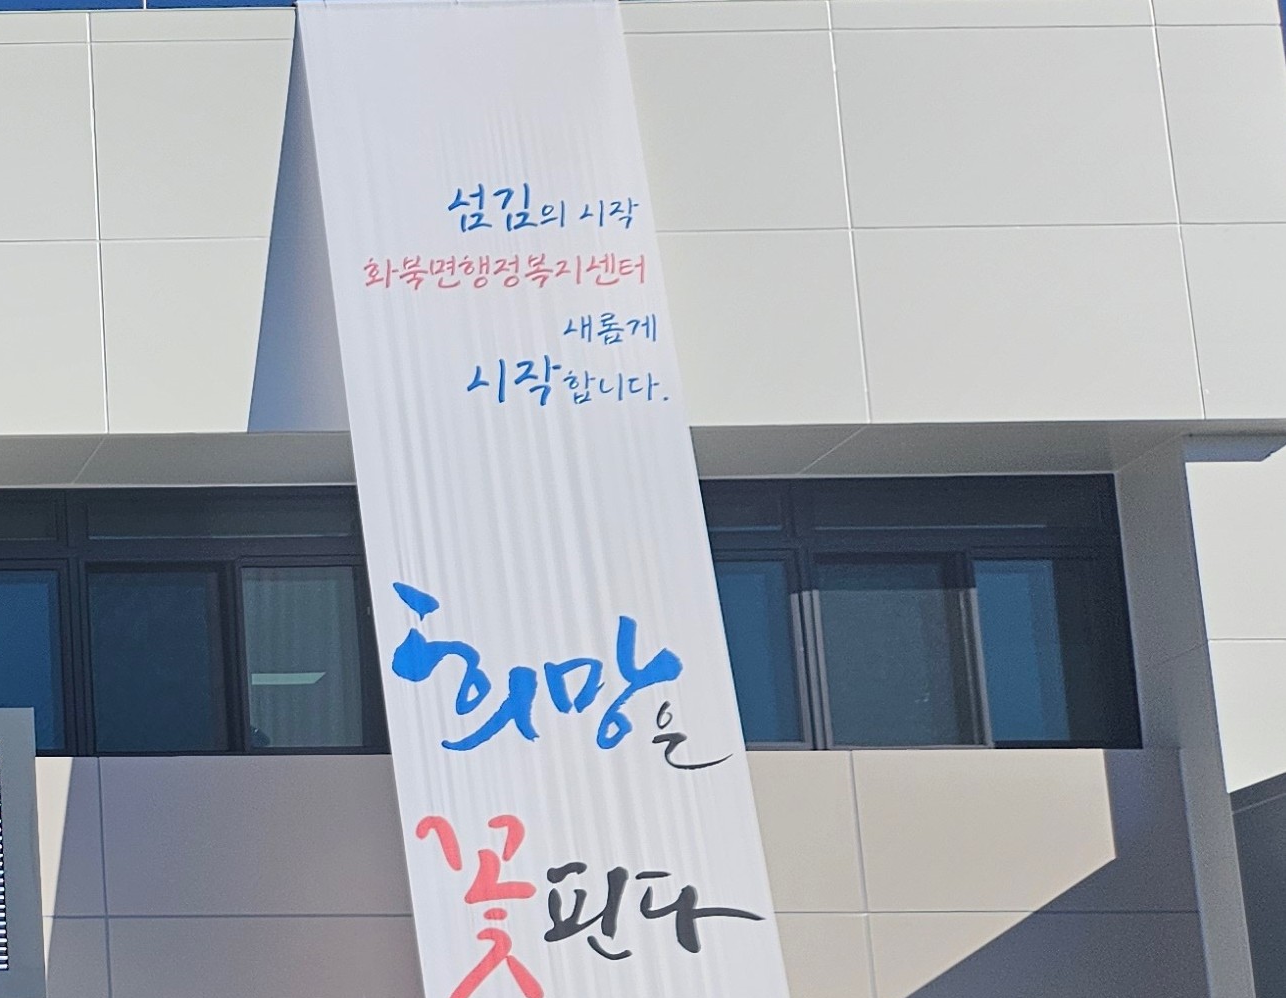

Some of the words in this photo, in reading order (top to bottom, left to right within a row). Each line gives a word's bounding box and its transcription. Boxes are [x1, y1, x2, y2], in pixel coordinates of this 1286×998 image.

[448, 183, 565, 232] 섬김의
[579, 197, 640, 229] 시작
[363, 252, 646, 291] 화북면행정복지센터
[563, 312, 658, 345] 새롭게
[466, 355, 670, 407] 시작합니다.
